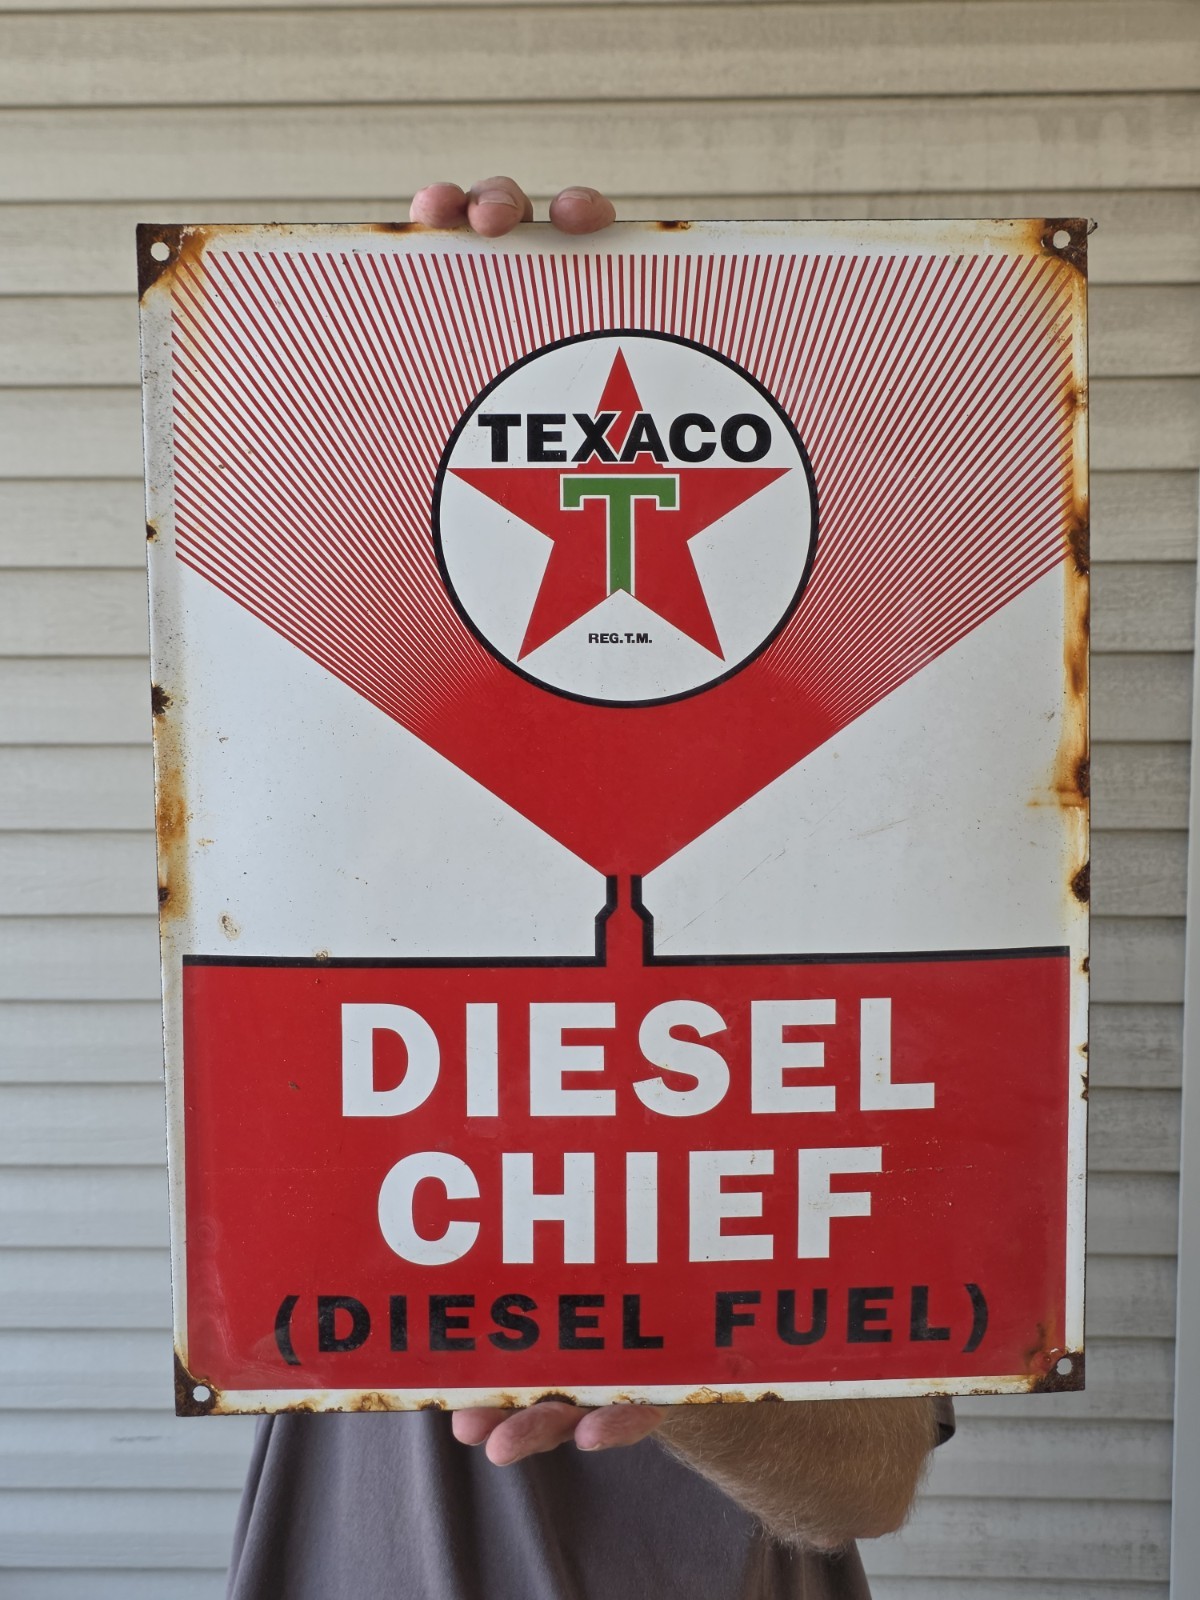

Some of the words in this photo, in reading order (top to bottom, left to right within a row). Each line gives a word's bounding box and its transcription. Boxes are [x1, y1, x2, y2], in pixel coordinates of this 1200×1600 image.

[478, 413, 772, 463] TEXACO
[341, 998, 935, 1118] DIESEL
[378, 1146, 883, 1267] CHIEF
[274, 1293, 664, 1365] (DIESEL
[715, 1283, 989, 1354] FUEL)
